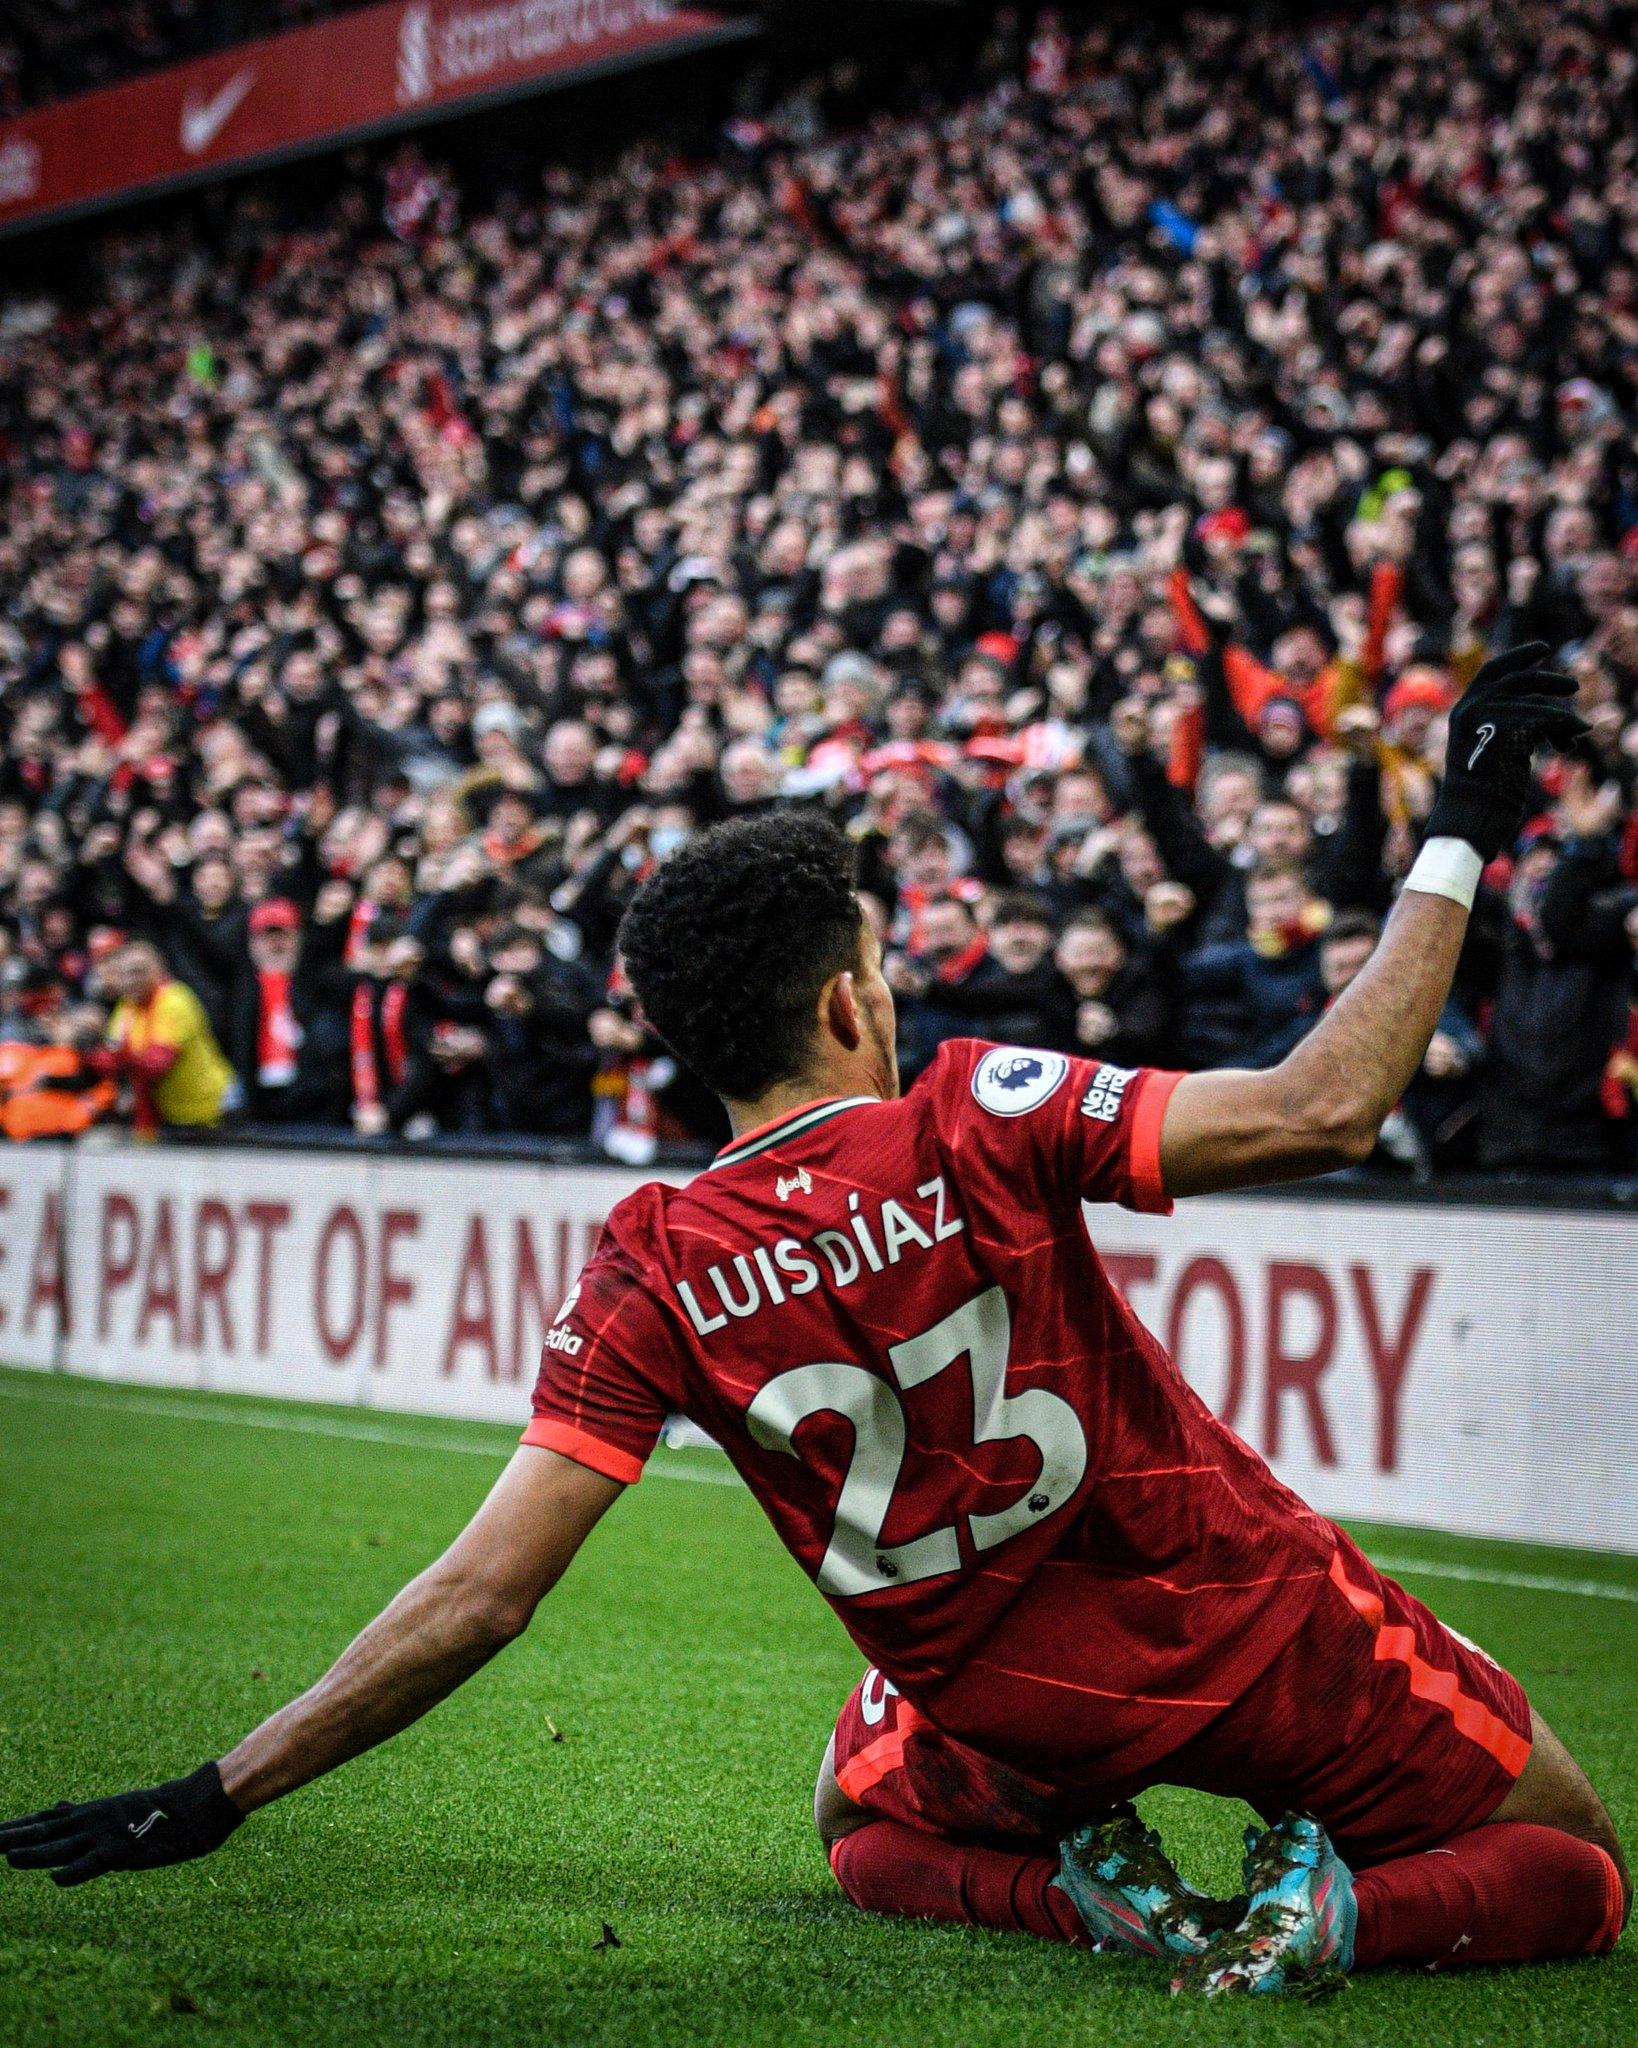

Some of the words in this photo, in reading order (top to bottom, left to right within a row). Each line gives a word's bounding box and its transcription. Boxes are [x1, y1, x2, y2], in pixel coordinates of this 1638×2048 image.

[1081, 1089, 1104, 1118] No
[24, 1190, 73, 1333] A
[98, 1192, 291, 1357] PART
[315, 1201, 420, 1367] OF
[443, 1214, 603, 1381] AN
[676, 1239, 819, 1336] LUIS
[813, 1176, 965, 1287] DÍAZ
[746, 1285, 1088, 1597] 23
